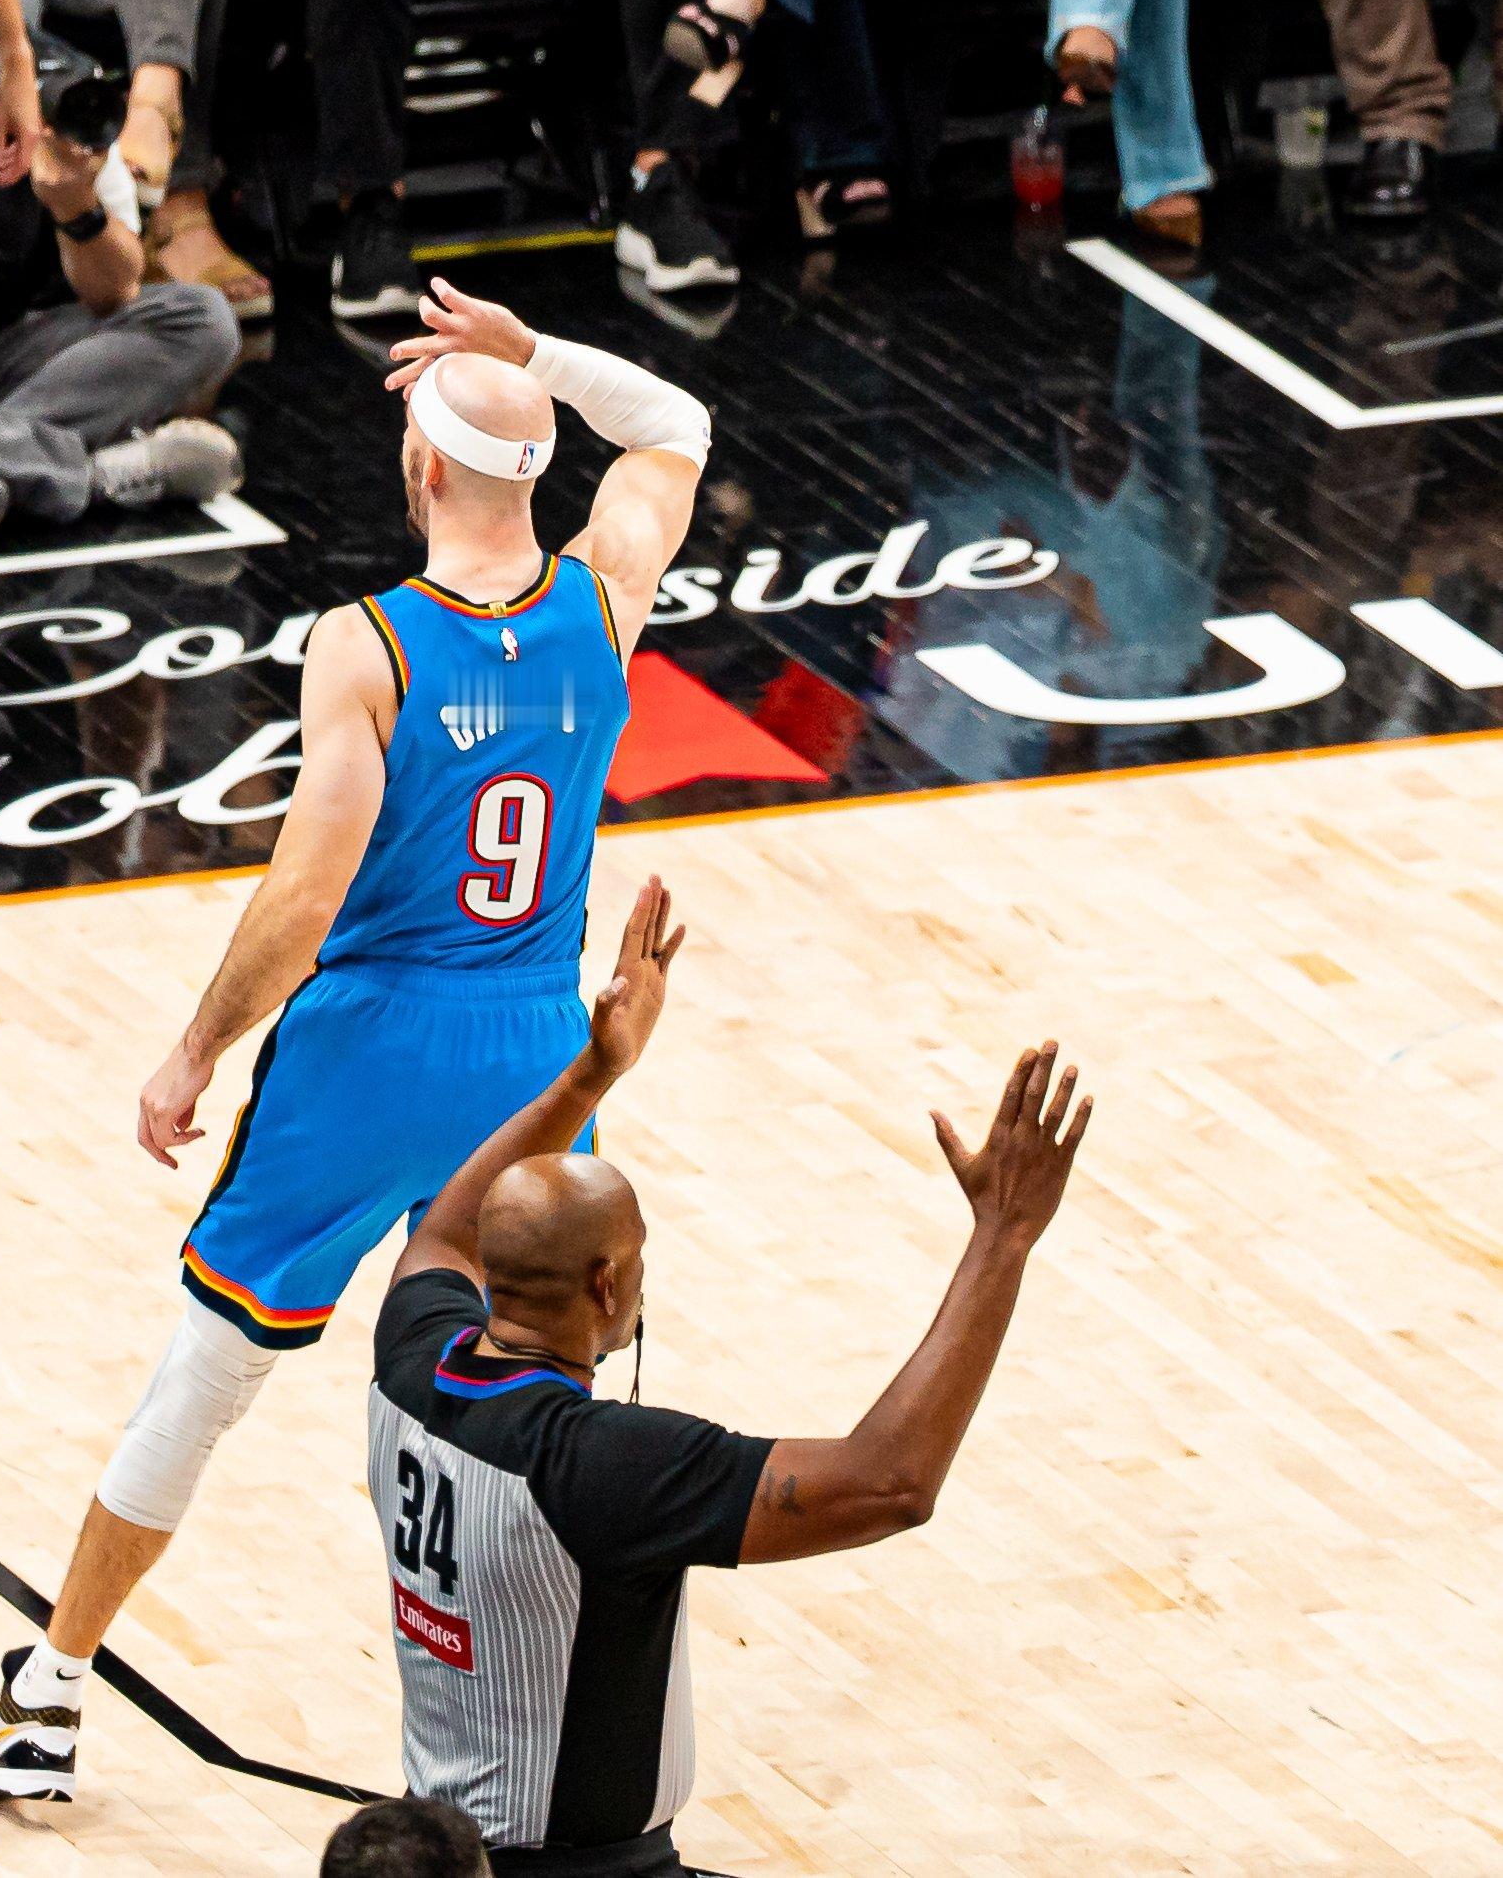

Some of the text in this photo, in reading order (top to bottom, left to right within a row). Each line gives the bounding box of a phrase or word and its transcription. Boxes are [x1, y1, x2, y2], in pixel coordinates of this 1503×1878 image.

[456, 771, 554, 928] 9
[394, 1448, 459, 1597] 34
[398, 1594, 463, 1654] Emirates
